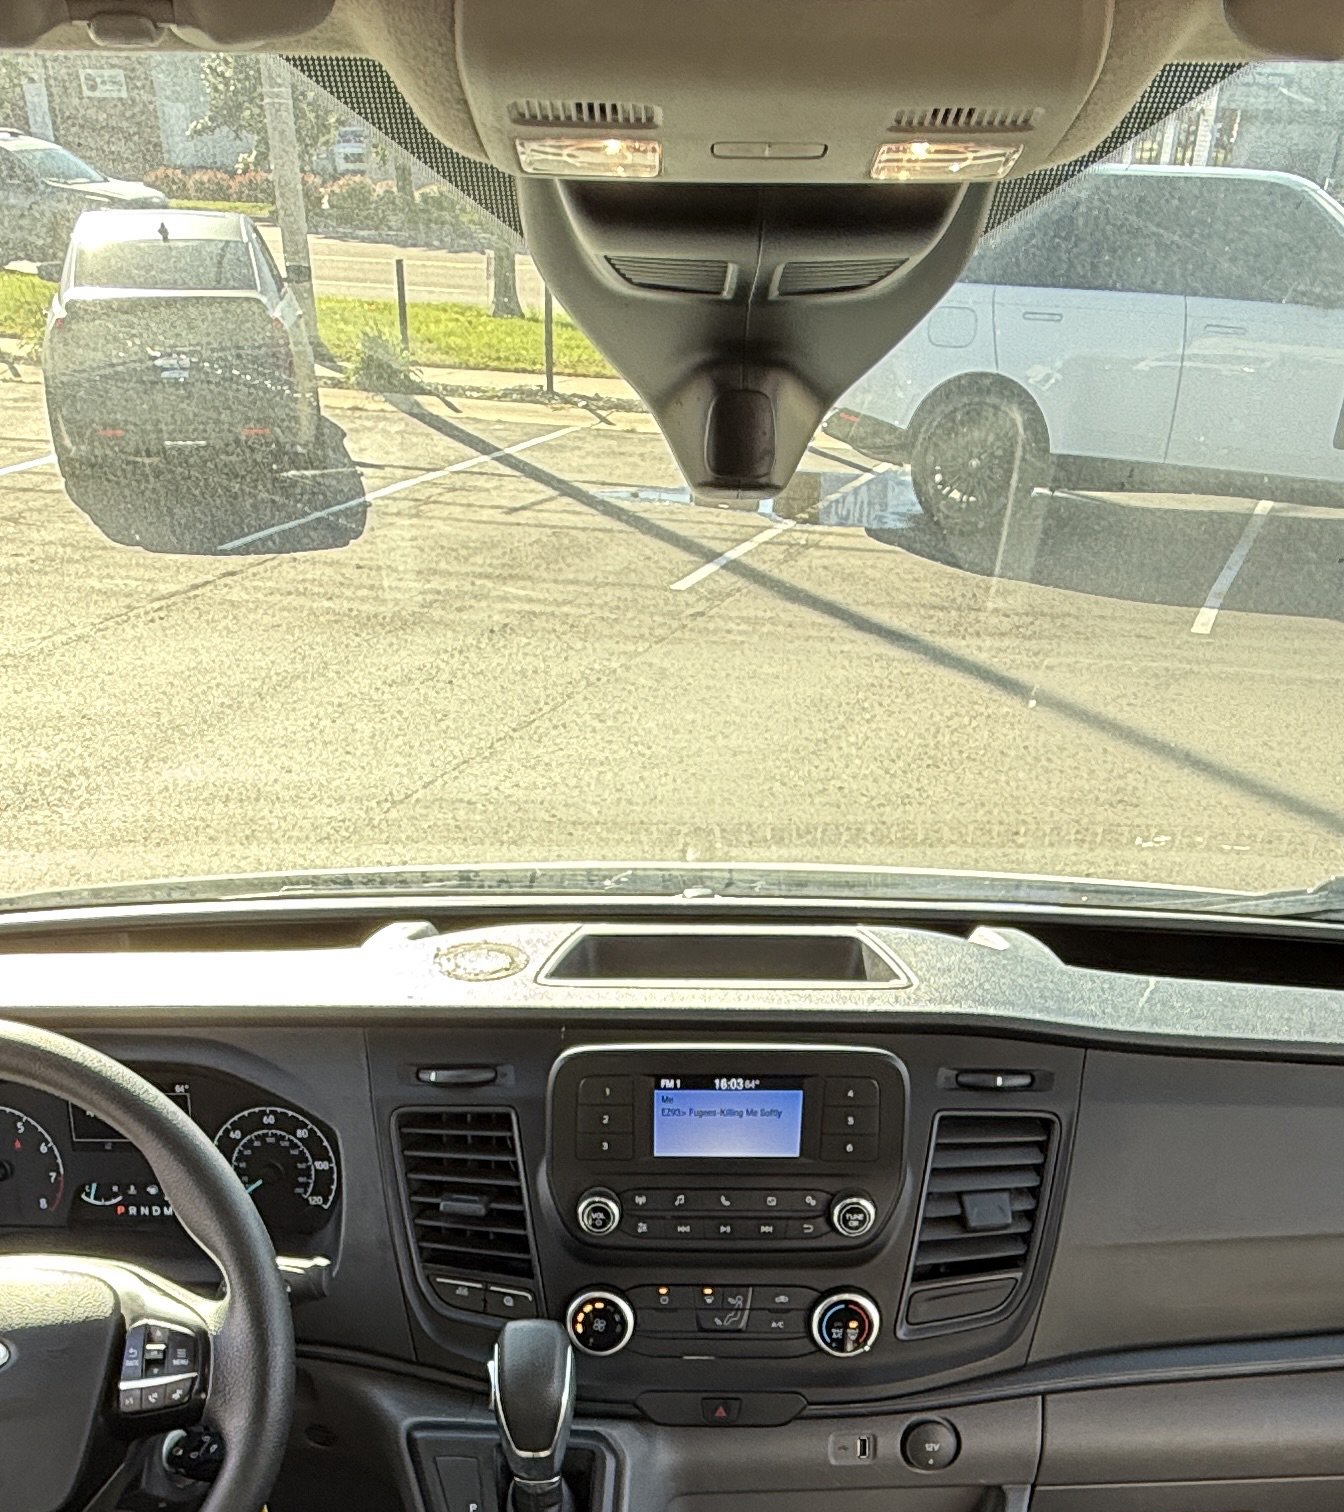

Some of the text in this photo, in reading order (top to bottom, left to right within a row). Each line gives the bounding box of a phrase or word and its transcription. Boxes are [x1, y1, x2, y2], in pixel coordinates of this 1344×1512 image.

[262, 1114, 276, 1125] 60
[16, 1122, 25, 1134] 5
[296, 1128, 309, 1139] 80
[39, 1142, 48, 1154] 6
[48, 1171, 57, 1183] 7
[39, 1198, 47, 1210] 8
[308, 1196, 323, 1206] 120
[116, 1205, 126, 1216] P
[128, 1206, 137, 1216] R
[140, 1206, 150, 1216] N
[152, 1206, 161, 1216] D
